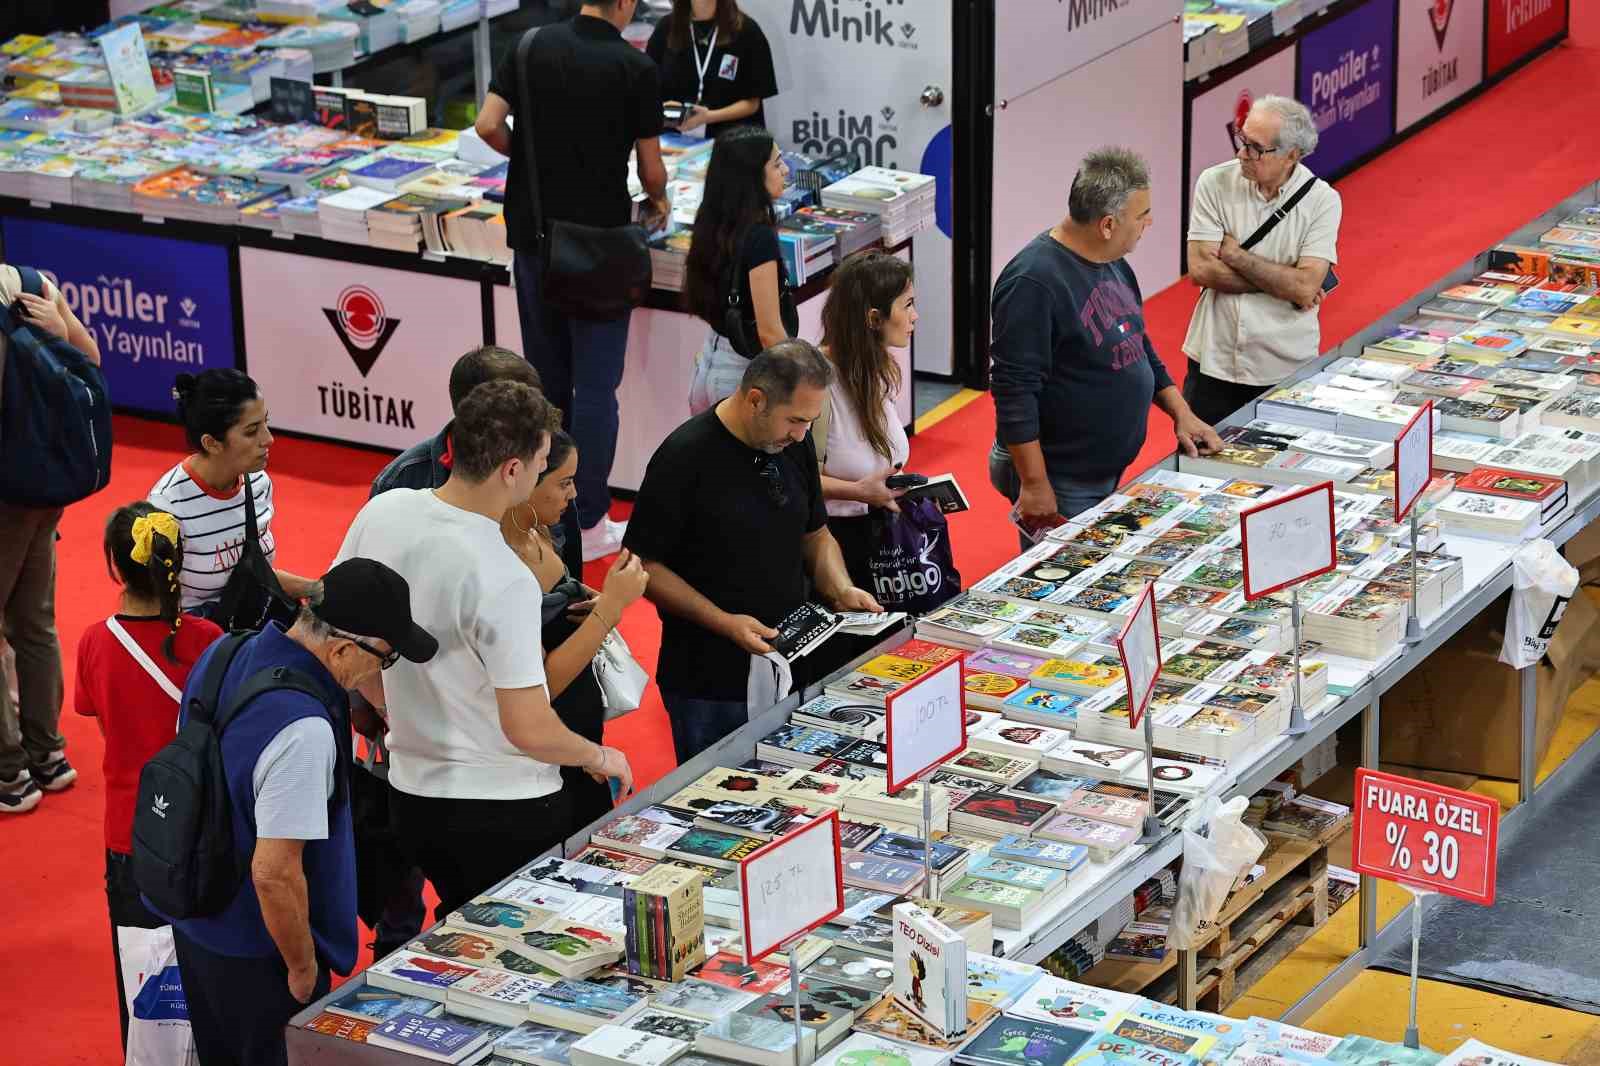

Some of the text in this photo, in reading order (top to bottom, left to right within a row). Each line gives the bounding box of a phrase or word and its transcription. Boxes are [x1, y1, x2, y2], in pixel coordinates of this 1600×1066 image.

[789, 0, 895, 47] Minik
[1311, 49, 1369, 105] Popüler
[1421, 57, 1459, 99] TÜBİTAK
[792, 109, 873, 144] BİLİM
[101, 322, 204, 365] Yayınları
[317, 381, 416, 429] TÜBİTAK
[872, 567, 942, 596] indigo
[1367, 785, 1483, 836] FUARA ÖZEL
[1385, 821, 1459, 880] % 30
[898, 920, 940, 959] TEO Dizisi
